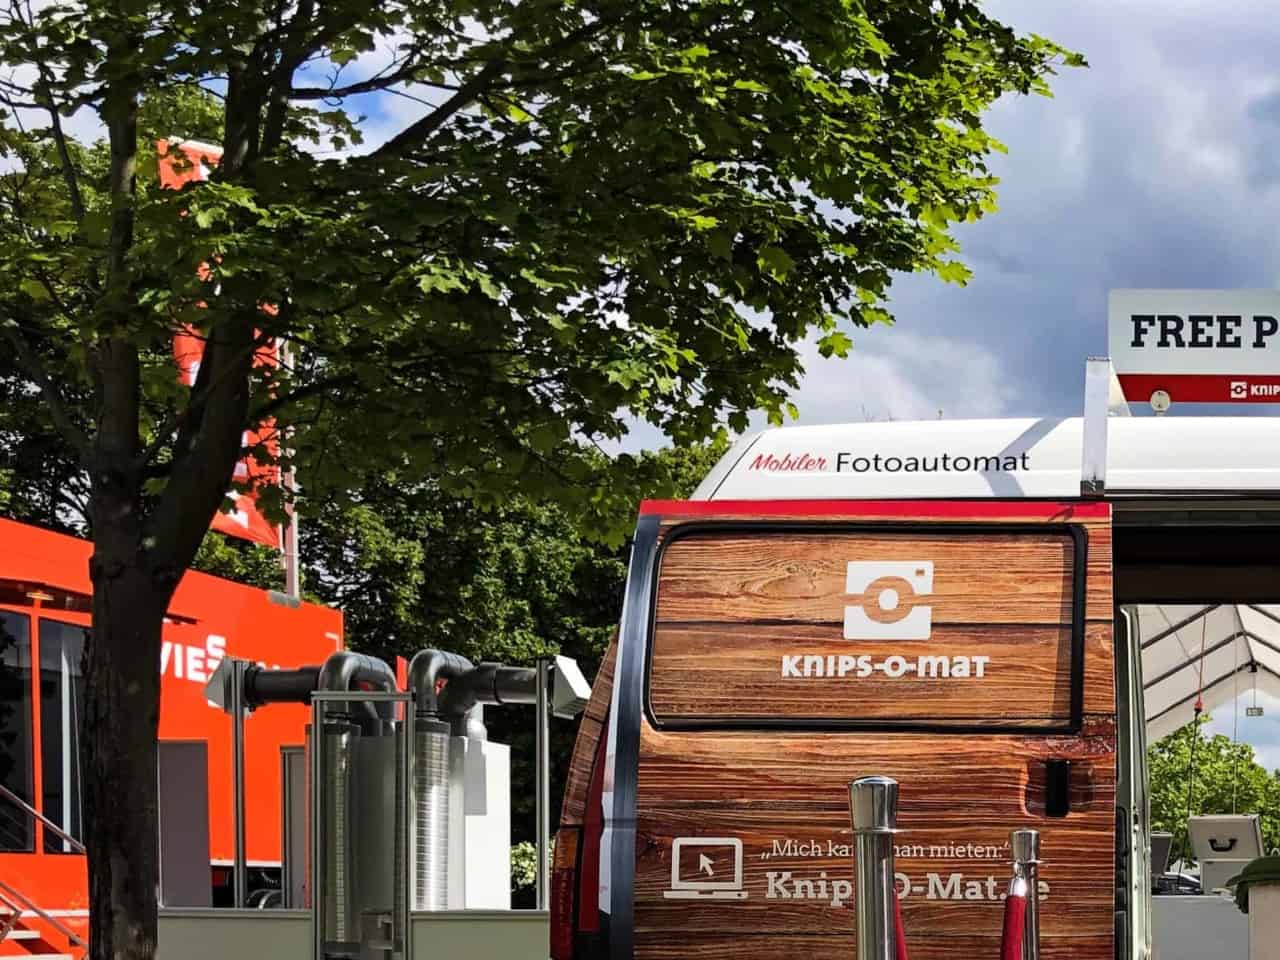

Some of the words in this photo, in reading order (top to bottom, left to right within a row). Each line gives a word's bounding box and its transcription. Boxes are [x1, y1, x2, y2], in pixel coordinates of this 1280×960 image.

[1131, 315, 1242, 348] FREE
[749, 453, 828, 472] Mobiler
[836, 452, 1031, 473] Fotoautomat
[827, 839, 854, 857] ka
